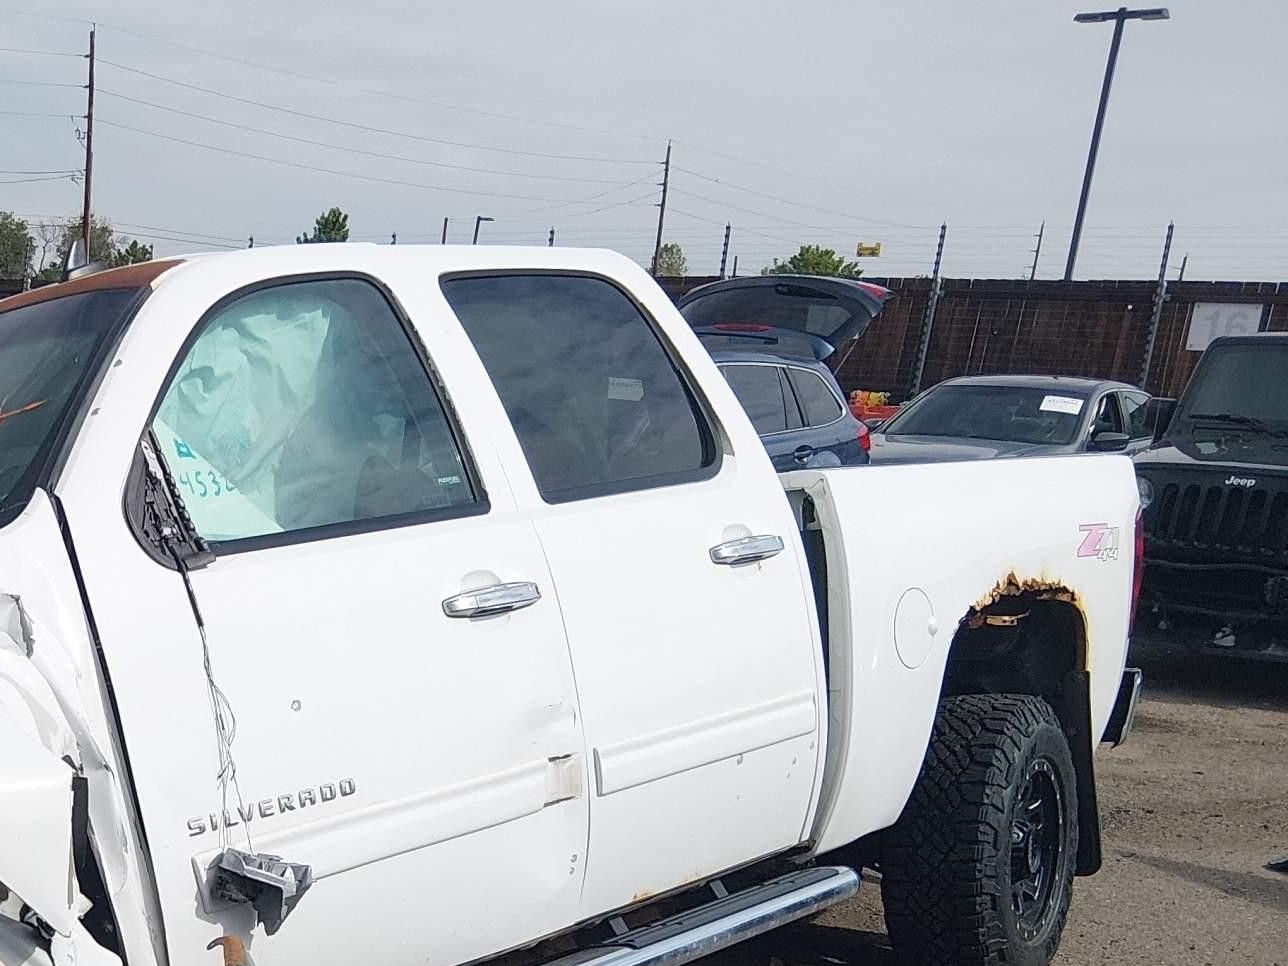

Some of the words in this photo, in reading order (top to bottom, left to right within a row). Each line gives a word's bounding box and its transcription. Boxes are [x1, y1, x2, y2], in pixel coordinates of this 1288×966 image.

[1224, 475, 1256, 488] Jeep
[1076, 522, 1120, 558] Z71
[187, 778, 356, 837] SILVERADO
